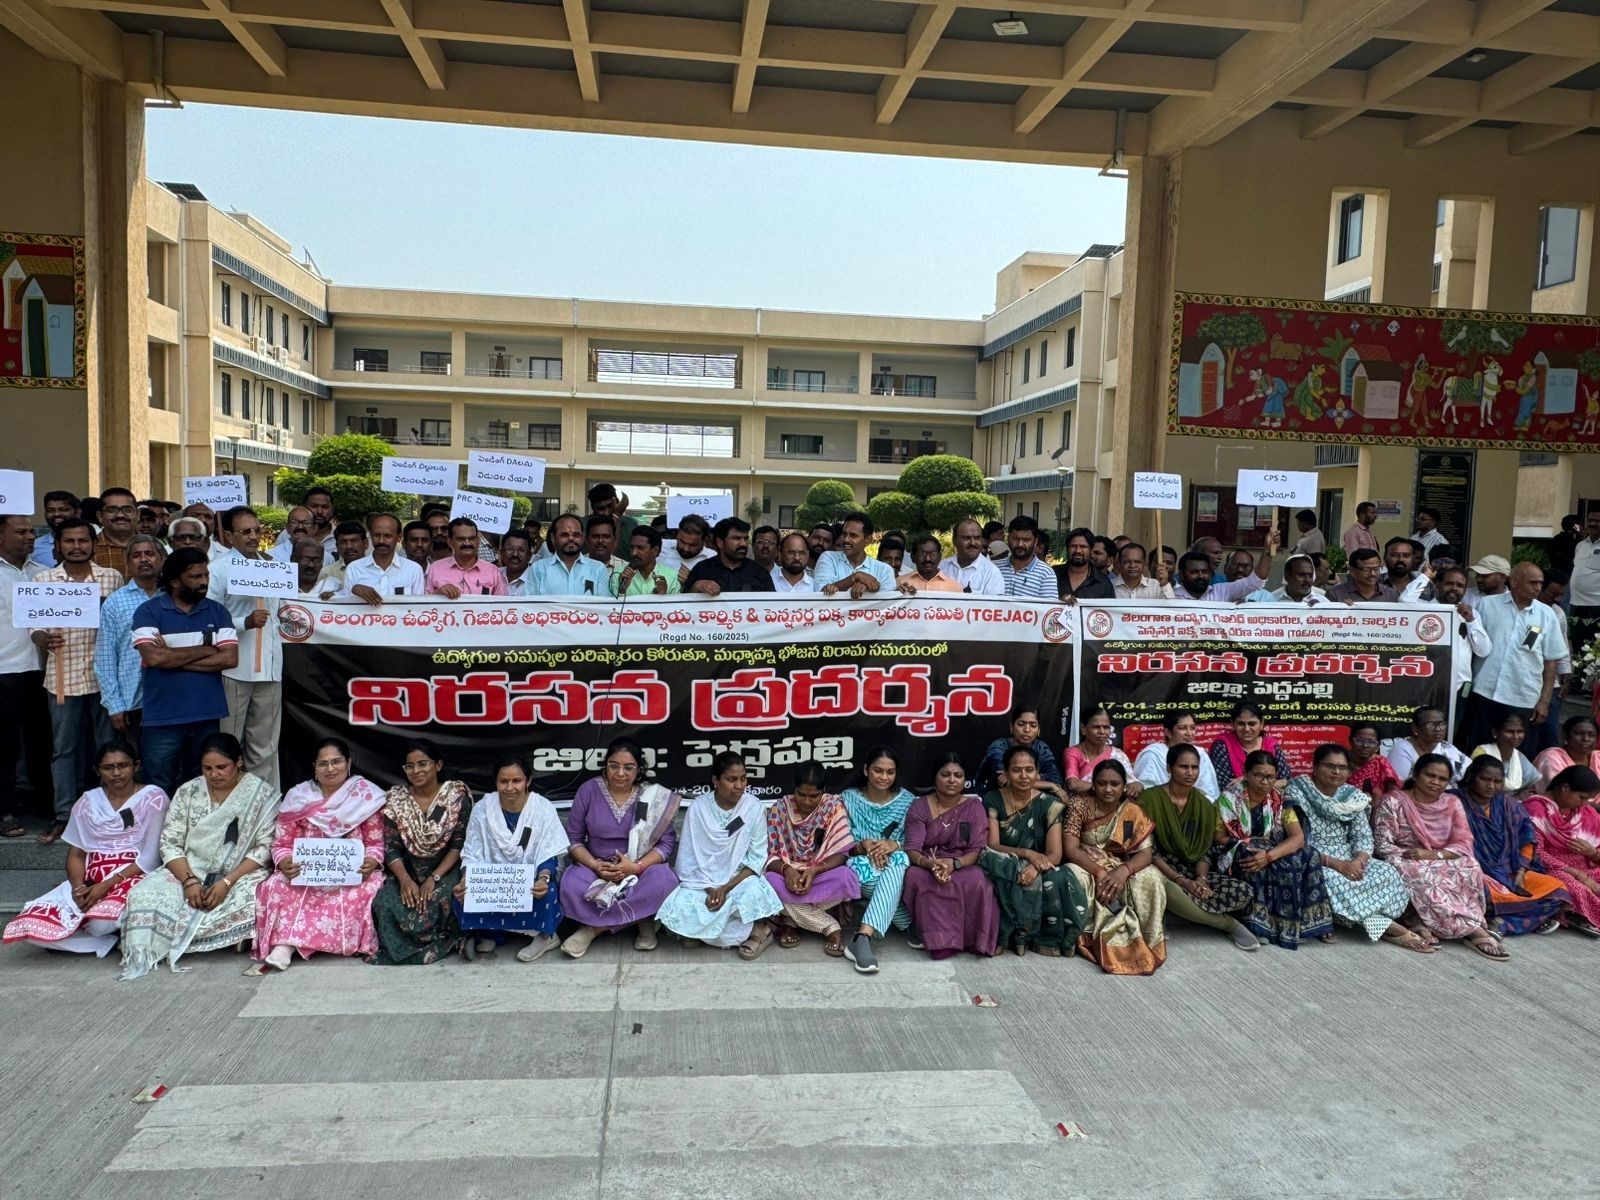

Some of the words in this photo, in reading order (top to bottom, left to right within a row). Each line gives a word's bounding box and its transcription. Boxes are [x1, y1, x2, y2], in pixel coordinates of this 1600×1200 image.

[1264, 474, 1278, 482] CPS
[186, 480, 202, 488] EHS
[456, 494, 472, 503] PRC
[231, 558, 250, 567] EHS
[18, 587, 40, 596] PRC
[46, 587, 54, 596] ని
[58, 586, 92, 596] వెంటనే
[319, 609, 397, 626] తెలంగాణ
[463, 608, 518, 627] గెజిటెడ్
[522, 609, 603, 628] అధికారుల,
[698, 608, 742, 630] కార్మిక
[746, 608, 760, 623] &
[818, 606, 846, 628] ఐక్య
[848, 606, 920, 627] కార్యాచరణ
[924, 606, 964, 622] సమితి
[967, 608, 1038, 626] (TGEJAC)
[1122, 612, 1171, 623] తెలంగాణ
[660, 633, 687, 643] (Regd
[690, 633, 704, 642] No.
[708, 632, 749, 642] 160/2025)
[1288, 629, 1325, 638] (TGEJAC)
[432, 648, 500, 669] ఉద్యోగుల
[504, 648, 568, 668] సమస్యల
[571, 648, 643, 667] పరిష్కారం
[714, 646, 776, 666] మధ్యాహ్న
[778, 644, 820, 660] భోజన
[822, 644, 866, 658] విరామ
[869, 642, 948, 658] సమయంలో
[1096, 651, 1248, 674] నిరసన
[1255, 652, 1434, 684] ప్రదర్శన
[1187, 681, 1248, 696] జిల్లా:
[1253, 680, 1334, 700] పెద్దపల్లి
[347, 670, 670, 725] నిరసన
[691, 664, 1014, 737] ప్రదర్శన
[1098, 702, 1201, 710] 17-04-2026
